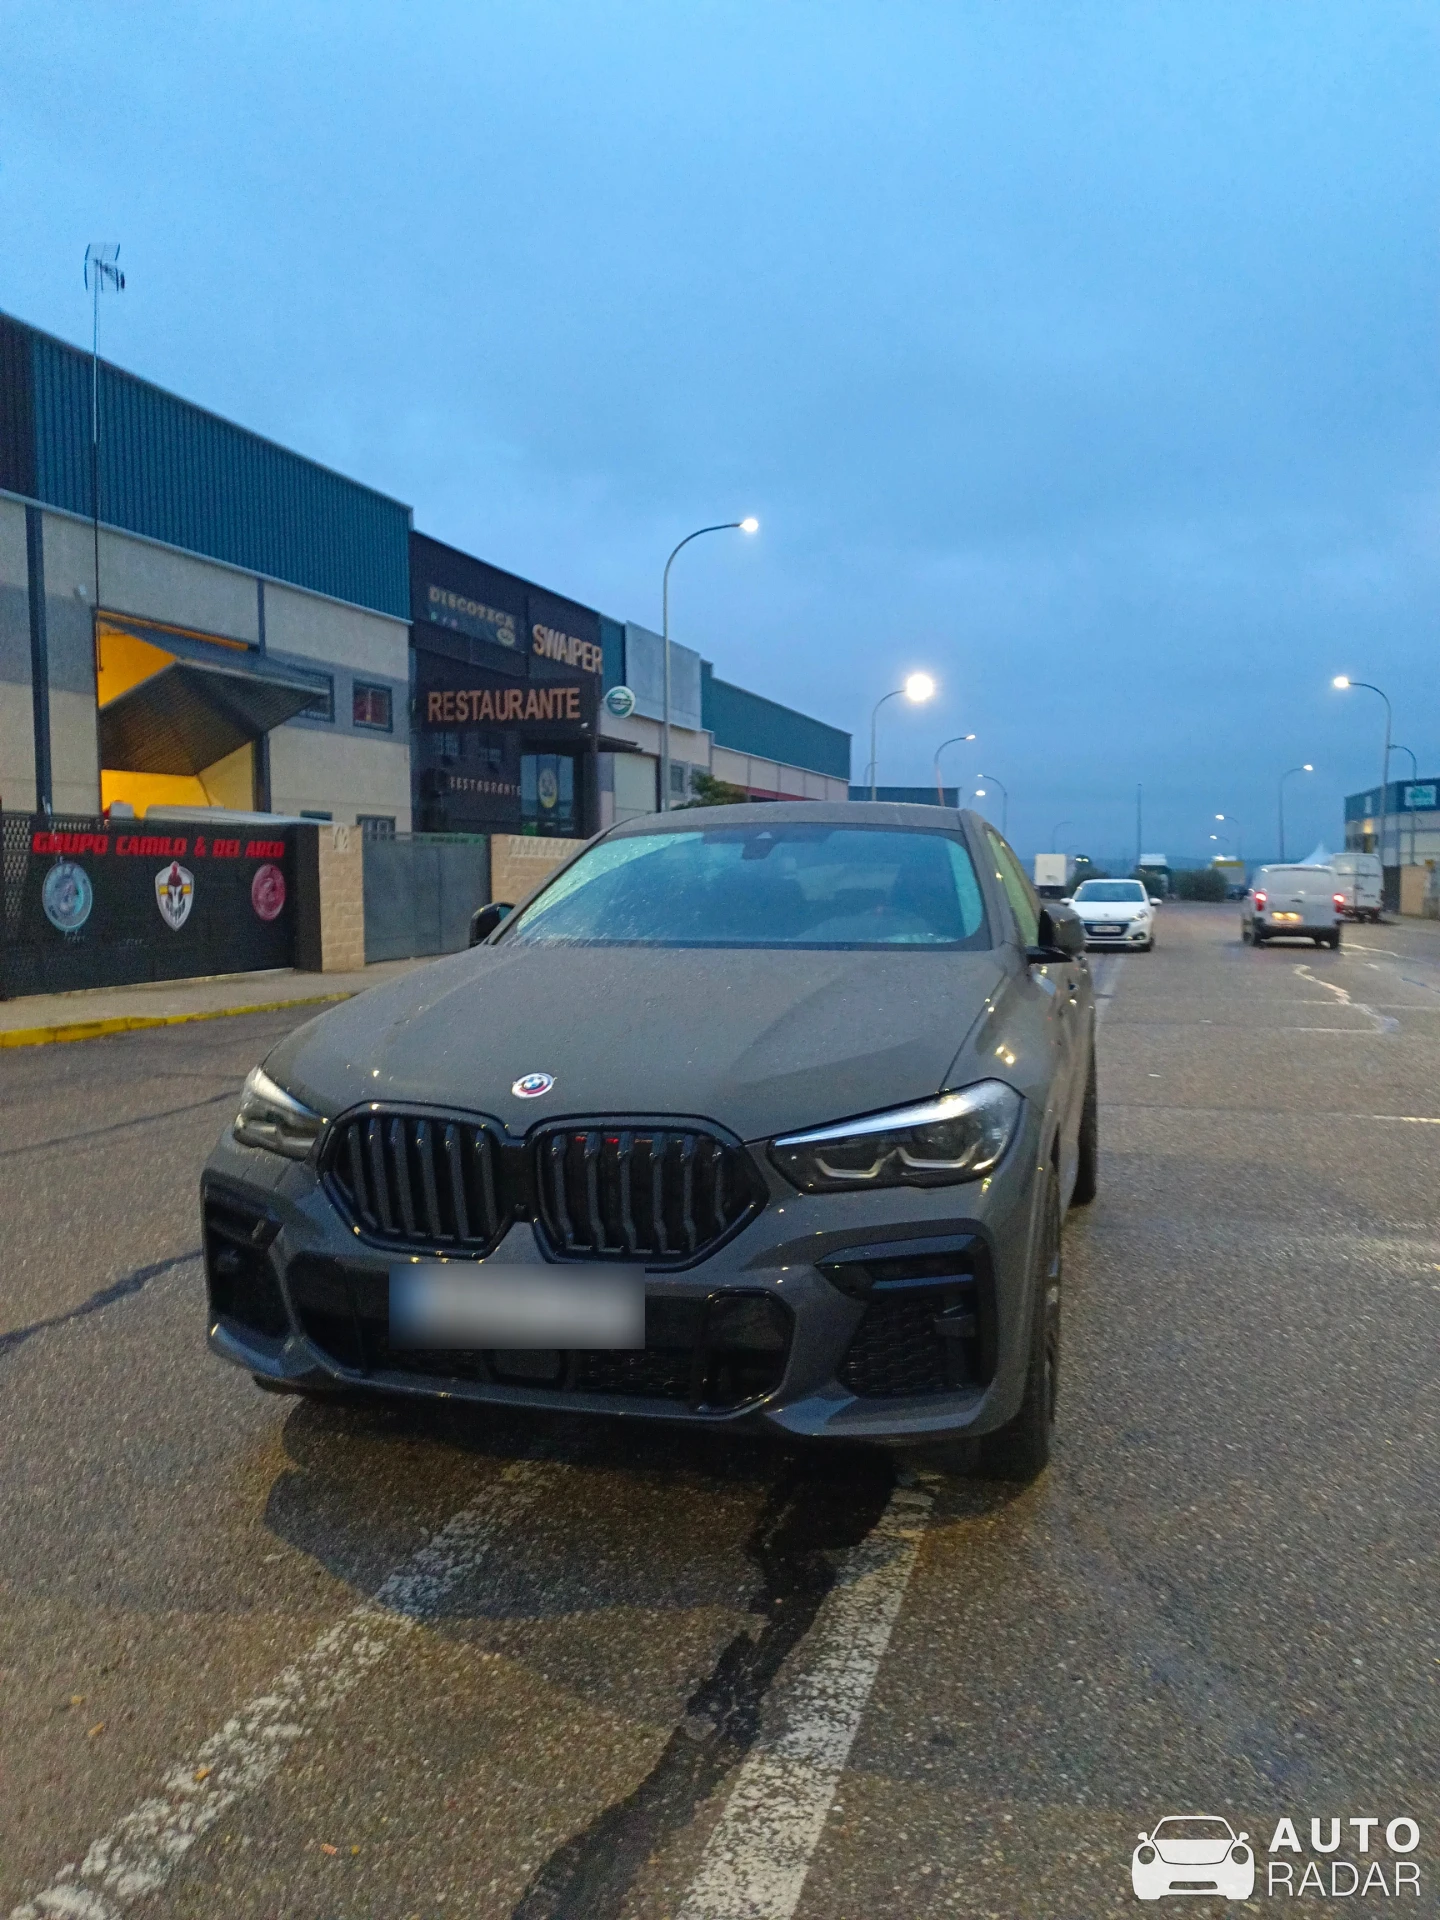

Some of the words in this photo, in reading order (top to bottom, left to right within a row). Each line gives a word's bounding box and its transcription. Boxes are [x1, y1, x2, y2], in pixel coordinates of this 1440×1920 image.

[429, 586, 515, 630] DISCOTECA
[427, 687, 581, 722] RESTAURANTE
[32, 831, 109, 855] GRUPO
[115, 835, 188, 857] CAMILO
[194, 836, 206, 857] &
[212, 839, 241, 858] DEL
[245, 840, 286, 859] ARCO
